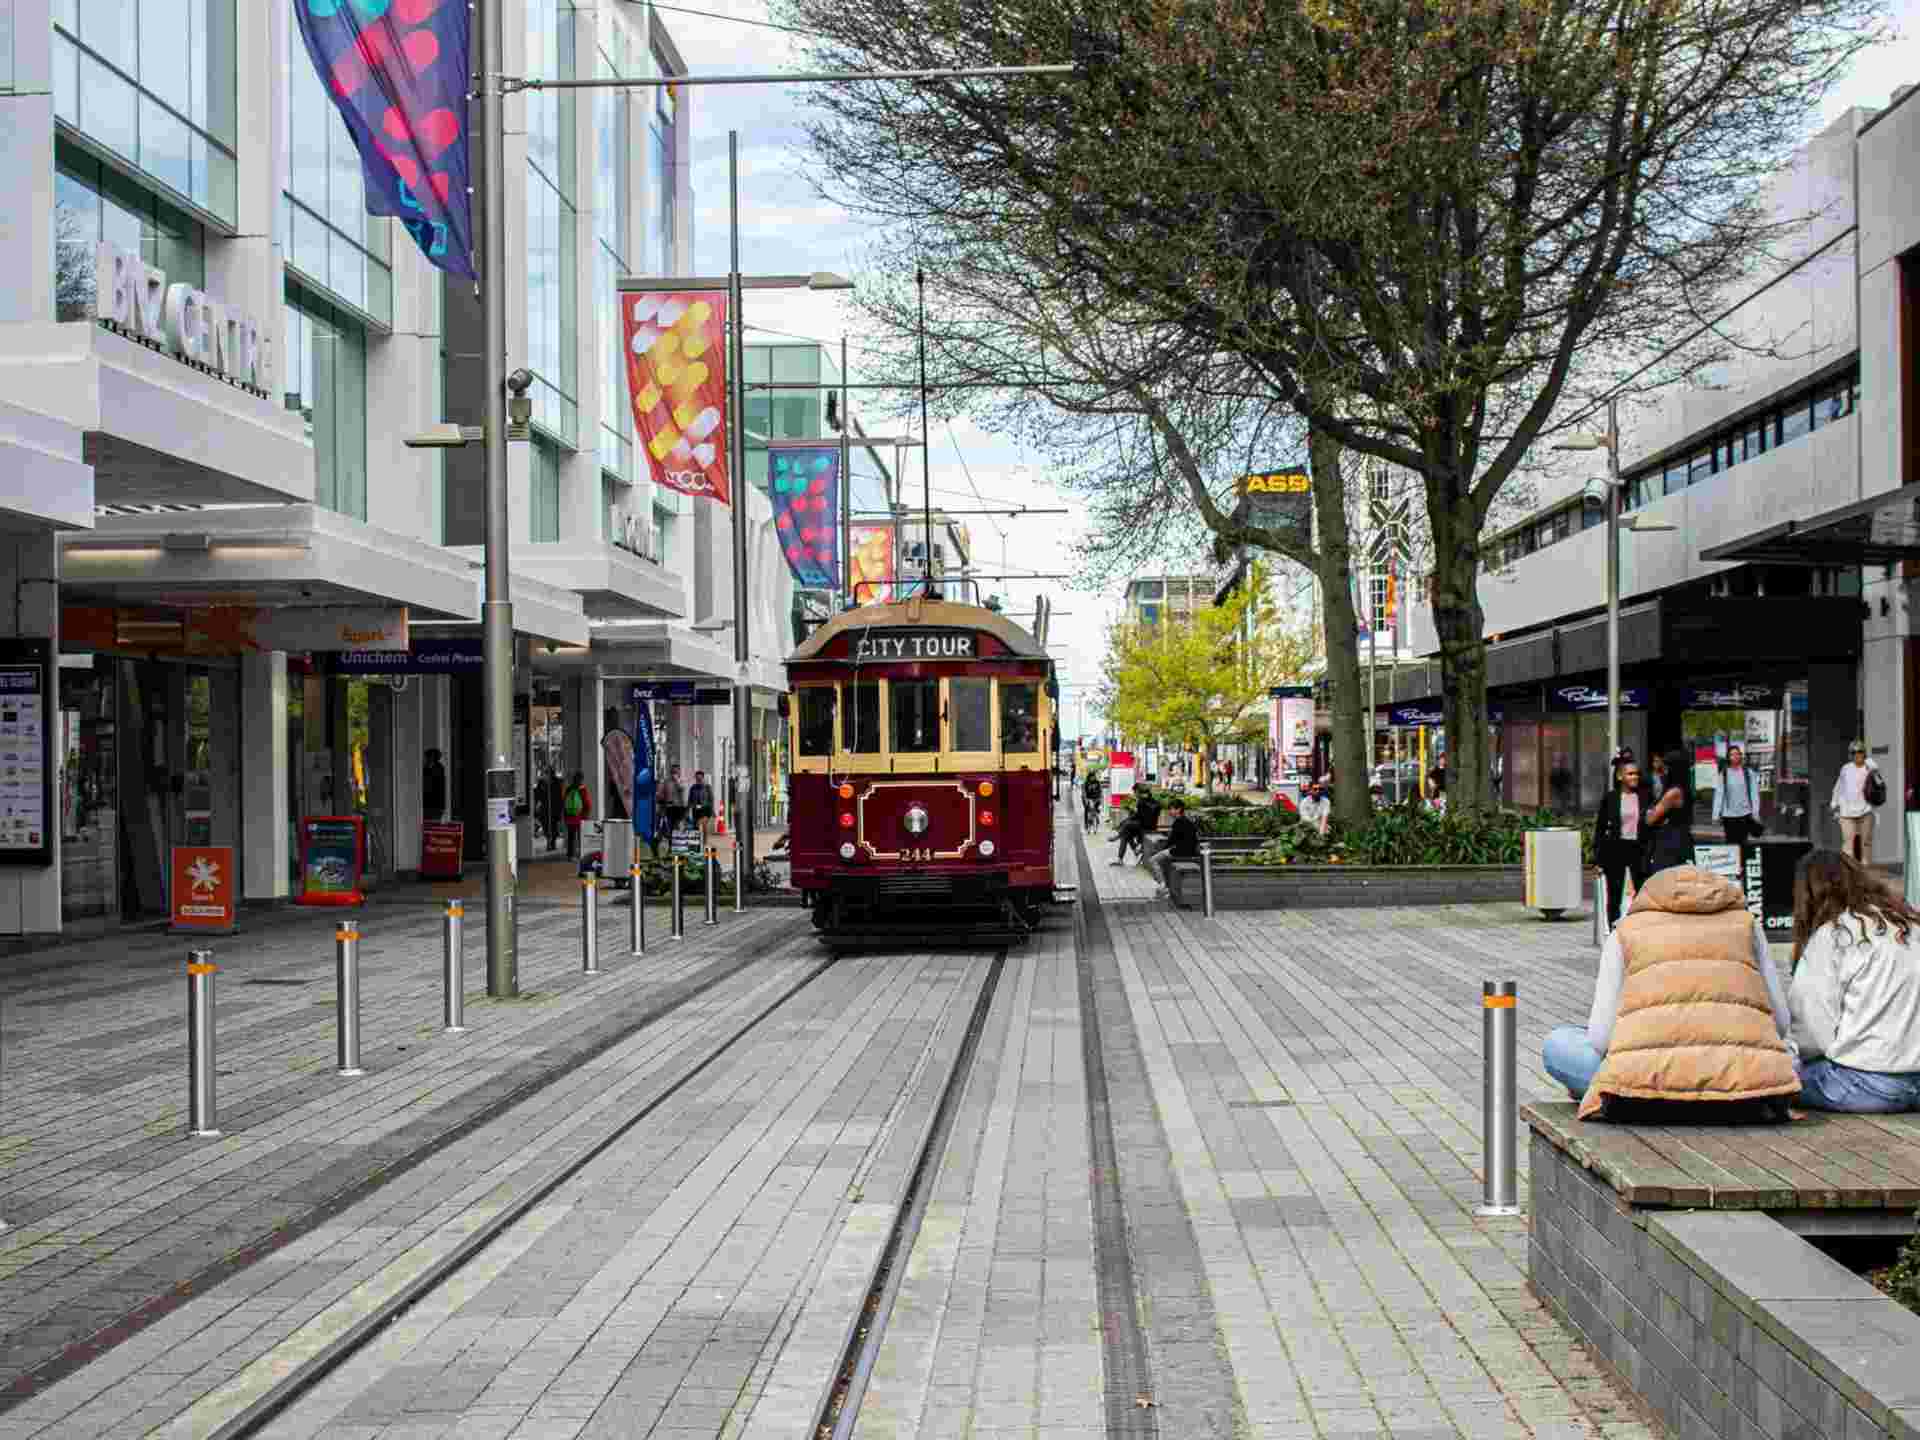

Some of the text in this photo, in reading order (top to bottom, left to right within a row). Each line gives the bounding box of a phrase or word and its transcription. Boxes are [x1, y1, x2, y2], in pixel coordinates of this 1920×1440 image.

[96, 239, 165, 351] BNZ
[856, 637, 971, 657] CITY TOUR
[340, 649, 409, 665] Unichem
[901, 847, 932, 861] 244
[1767, 916, 1795, 928] OPE
